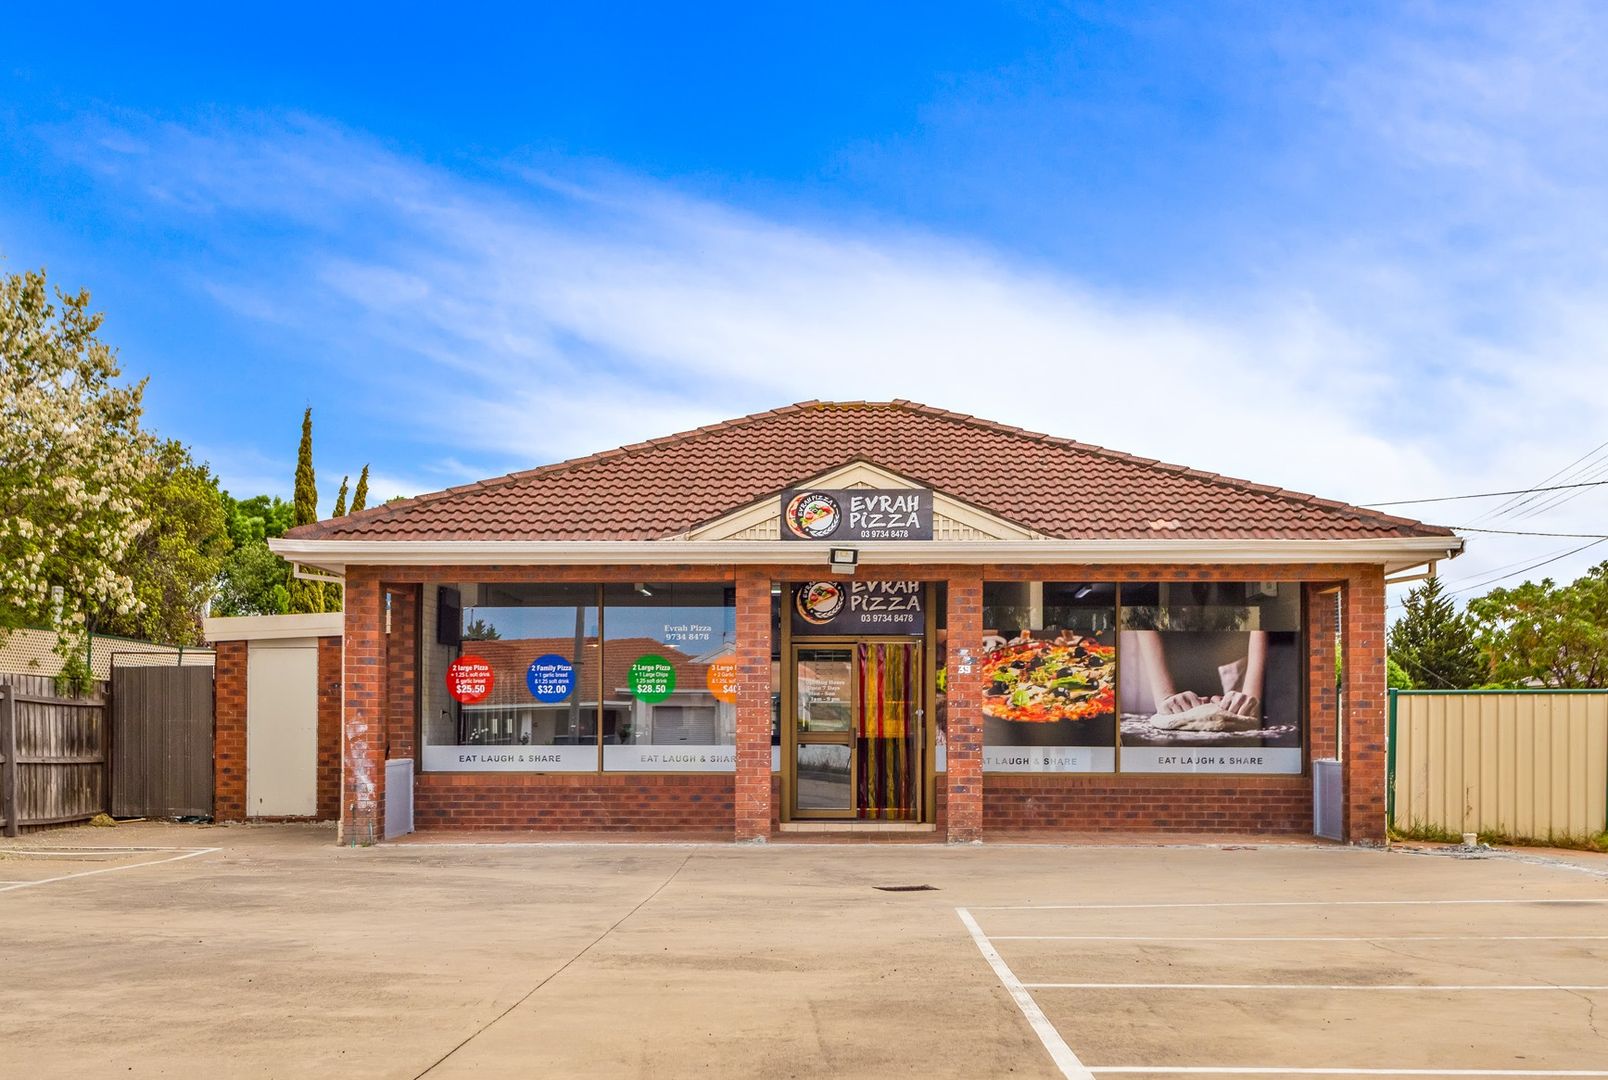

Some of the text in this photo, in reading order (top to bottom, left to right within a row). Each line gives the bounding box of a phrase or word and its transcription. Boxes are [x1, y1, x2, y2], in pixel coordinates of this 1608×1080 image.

[850, 495, 920, 513] EVRAH
[852, 581, 920, 594] EVRAH
[861, 614, 914, 622] 03 9734 8478
[456, 684, 486, 694] $25.50
[538, 684, 566, 694] $32.00
[637, 684, 666, 694] $28.50
[1044, 758, 1077, 766] SHARE
